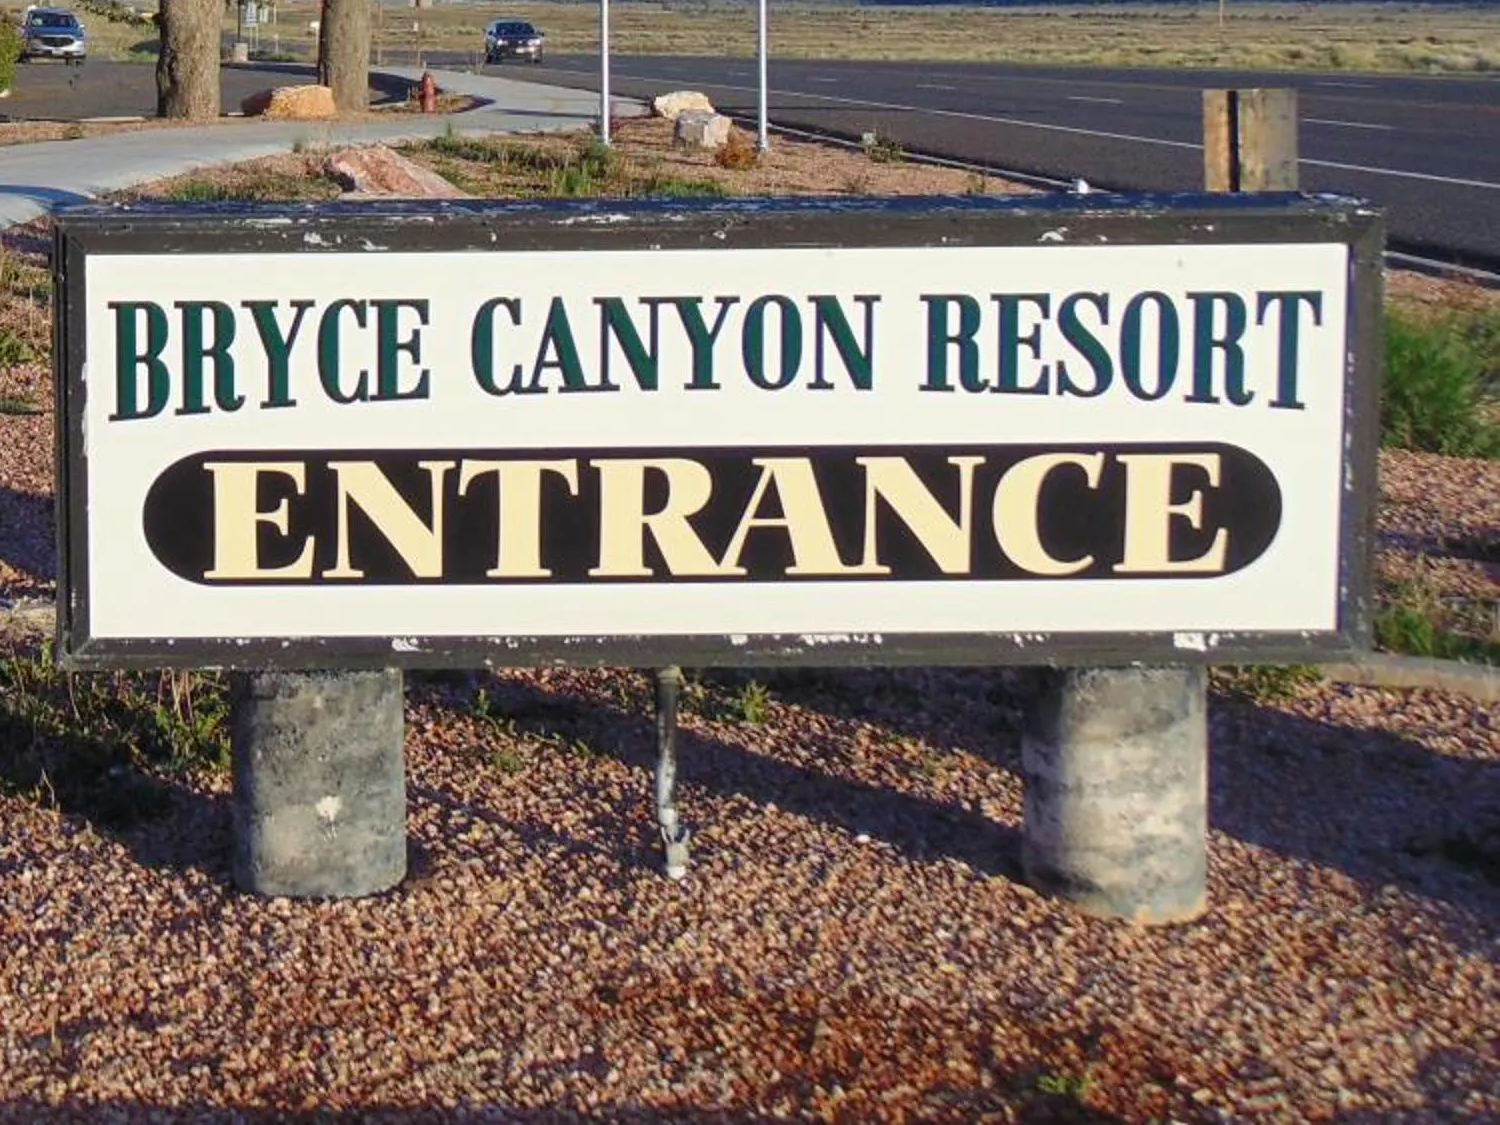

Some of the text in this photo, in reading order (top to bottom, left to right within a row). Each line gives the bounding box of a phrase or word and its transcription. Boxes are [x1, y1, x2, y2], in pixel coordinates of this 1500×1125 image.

[107, 290, 1322, 422] BRYCE CANYON RESORT
[202, 451, 1228, 579] ENTRANCE
